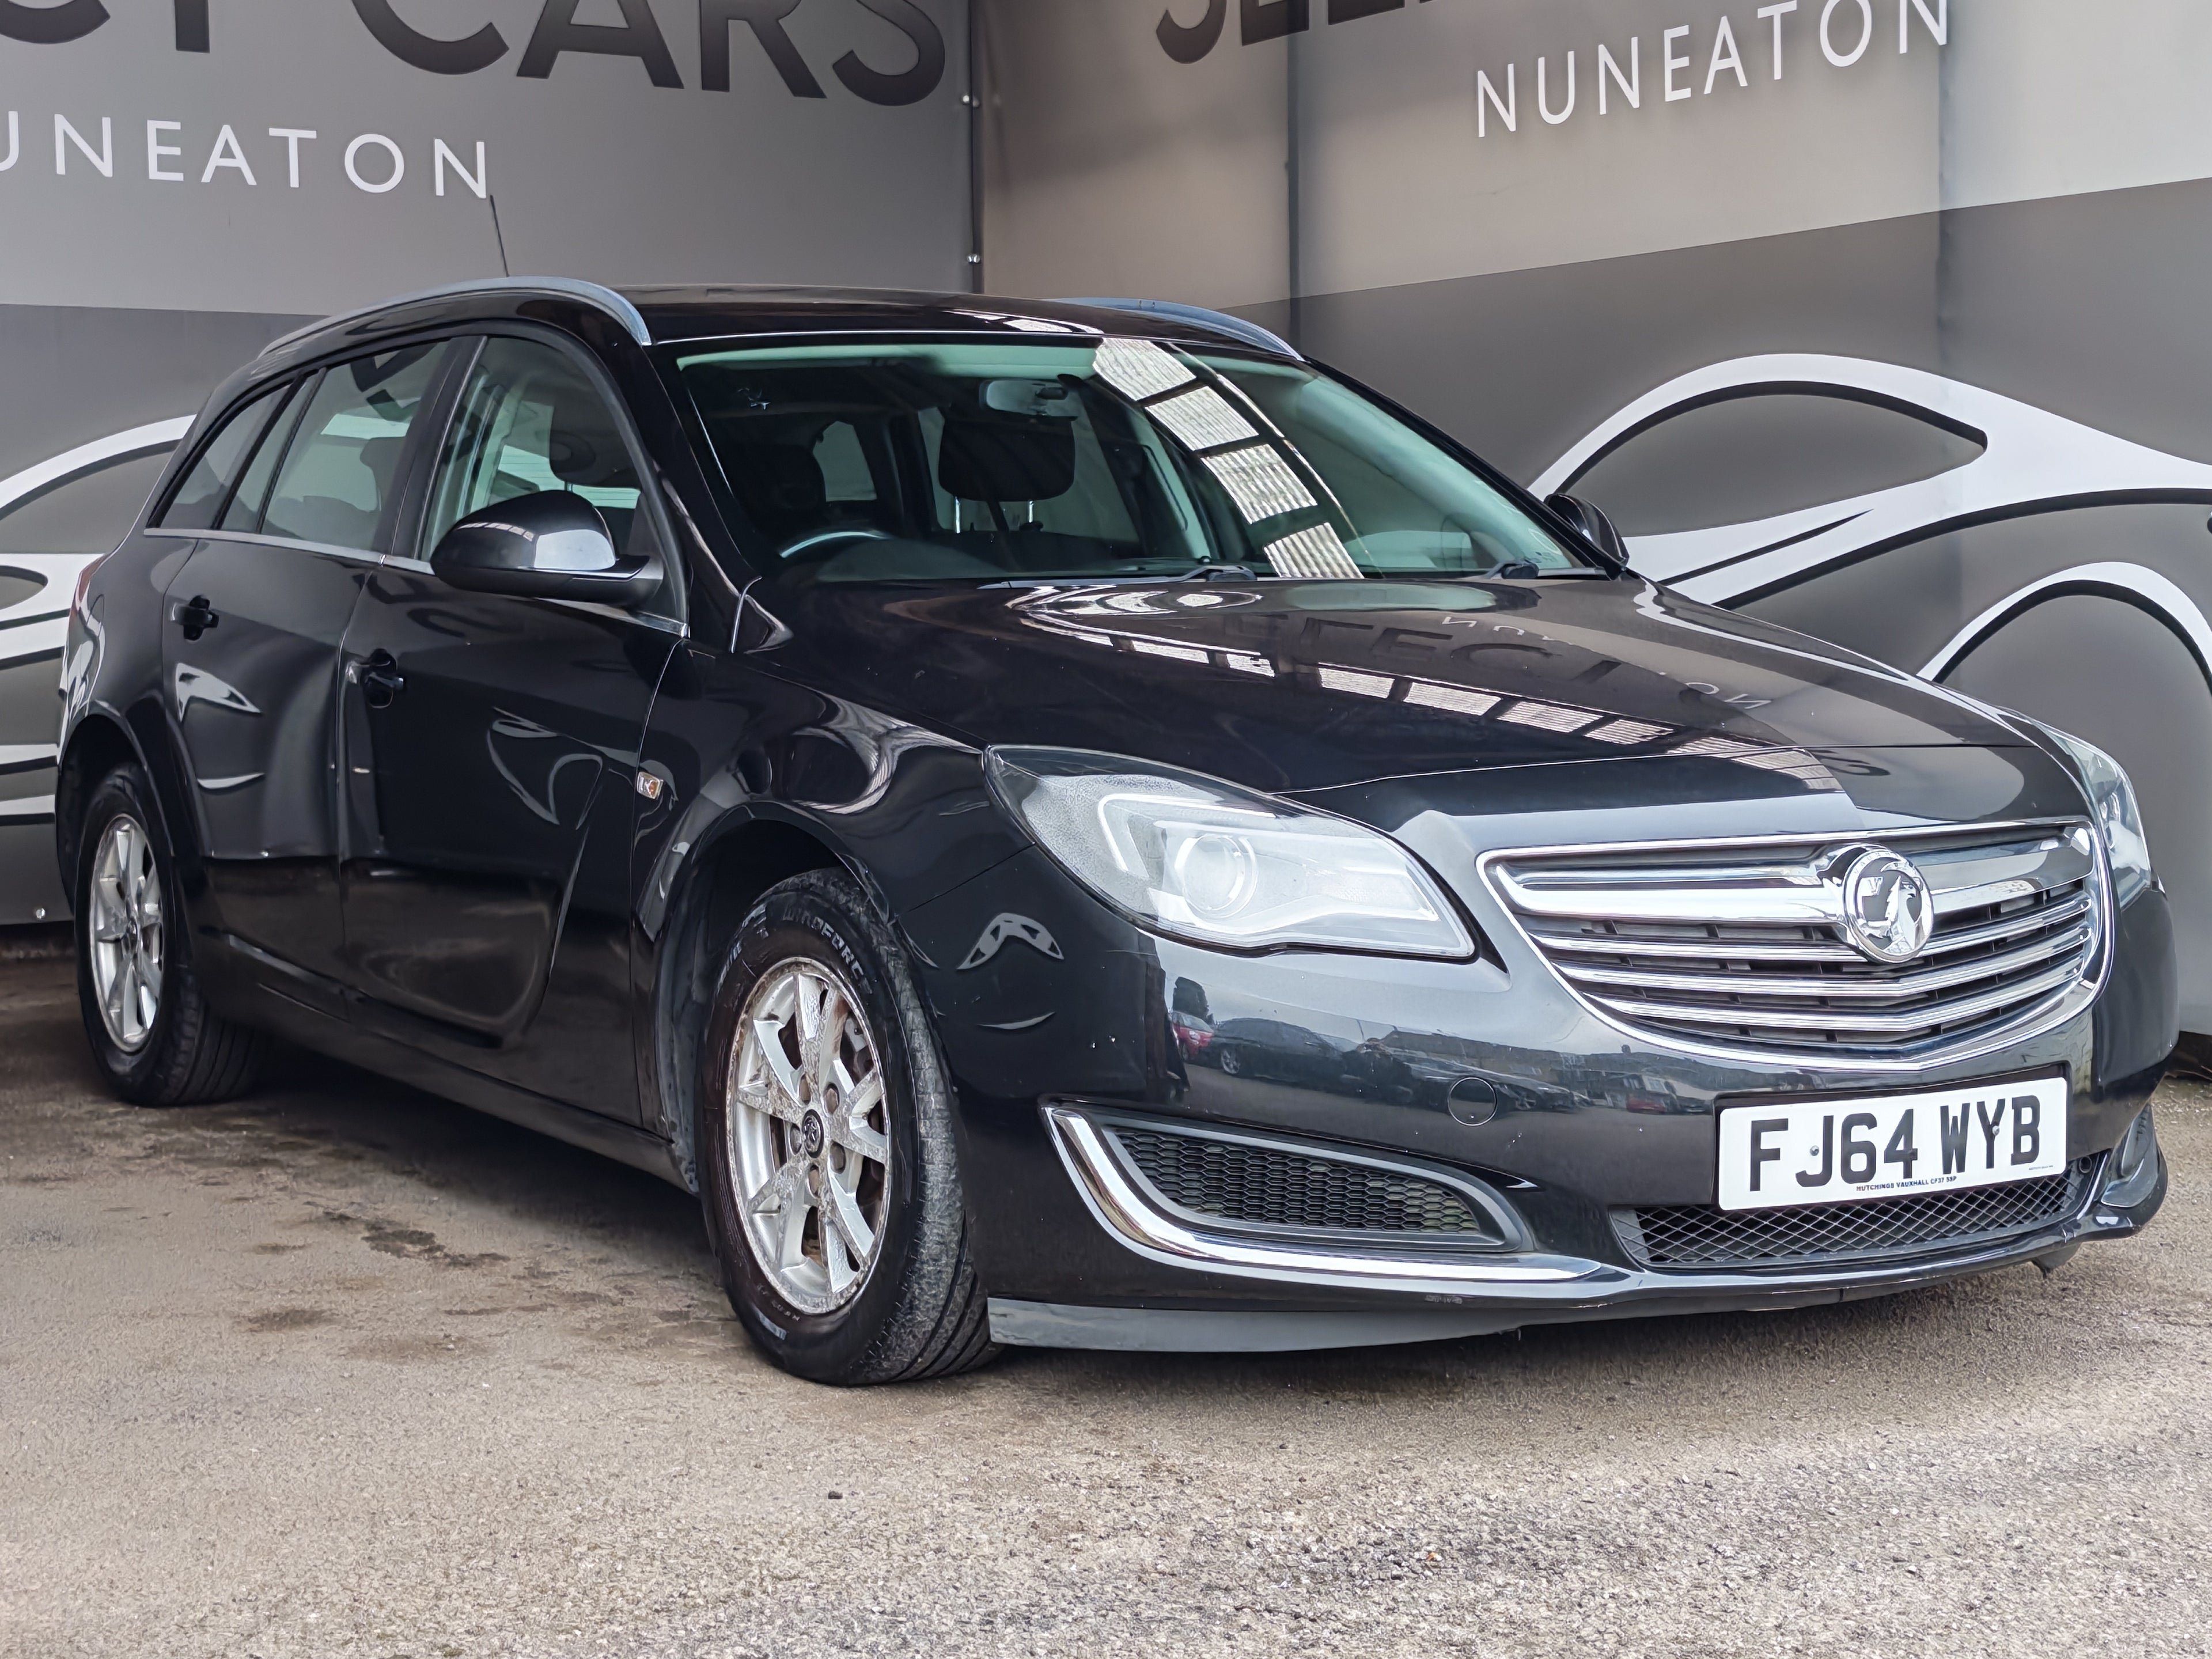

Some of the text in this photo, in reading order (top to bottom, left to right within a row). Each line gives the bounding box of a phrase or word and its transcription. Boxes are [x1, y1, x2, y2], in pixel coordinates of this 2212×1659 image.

[1478, 0, 1947, 138] NUNEATON
[1749, 1095, 2040, 1191] FJ64 WYB
[1896, 1179, 1929, 1188] VAUXHALL
